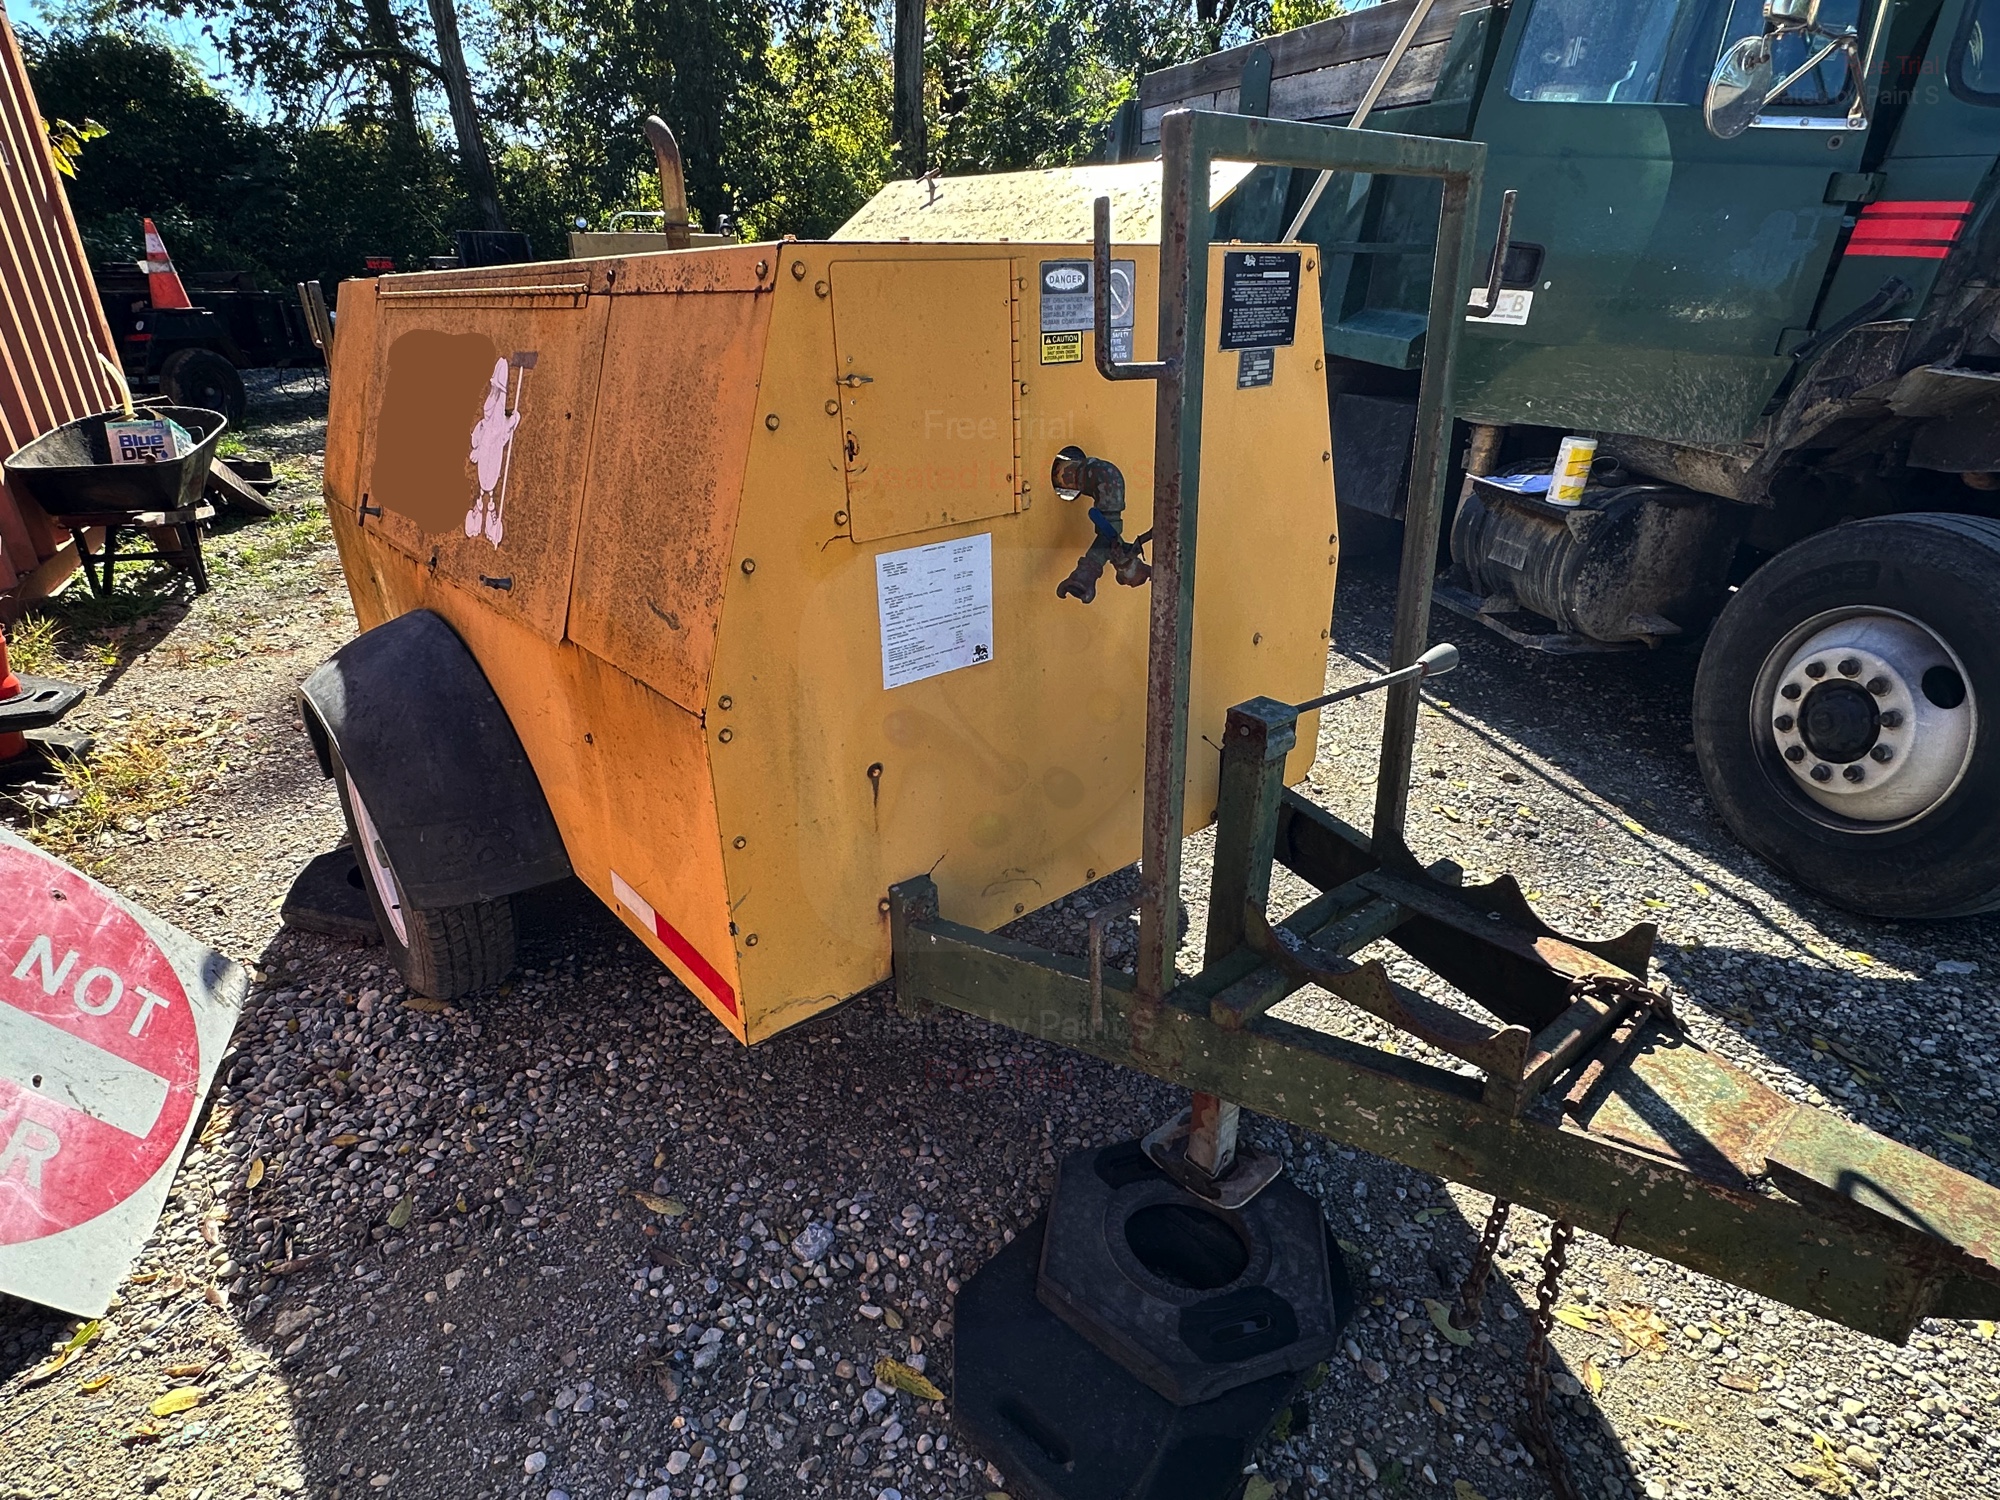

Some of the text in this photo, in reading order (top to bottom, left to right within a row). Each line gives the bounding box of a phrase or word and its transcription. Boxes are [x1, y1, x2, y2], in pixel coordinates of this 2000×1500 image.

[1049, 274, 1083, 284] DANGER
[1052, 334, 1078, 343] CAUTION
[118, 434, 163, 447] Blue
[121, 446, 164, 461] DEF
[12, 935, 171, 1038] NOT
